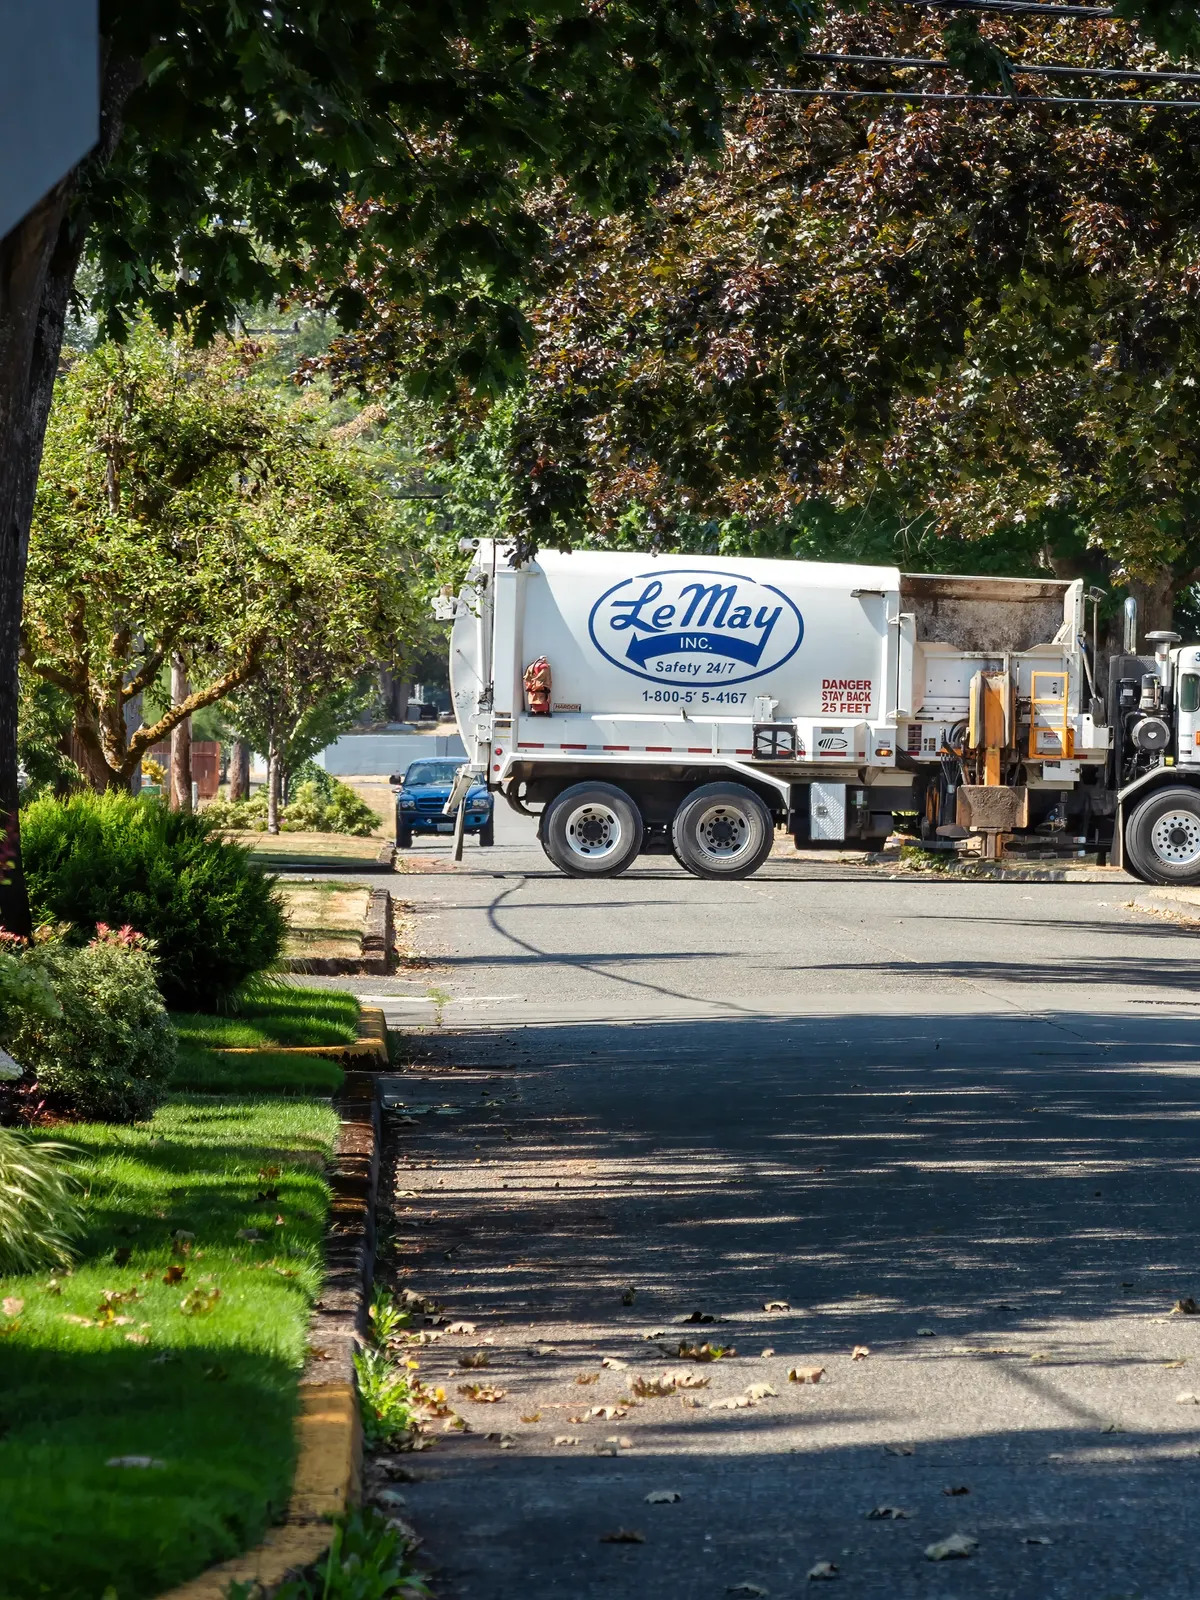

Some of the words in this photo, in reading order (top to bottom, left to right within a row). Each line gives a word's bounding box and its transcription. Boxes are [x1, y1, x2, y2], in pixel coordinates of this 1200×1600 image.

[680, 637, 713, 650] INC.
[655, 661, 701, 675] Safety
[706, 662, 736, 674] 24/7
[822, 679, 872, 690] DANGER
[642, 690, 747, 704] 1-800-55-4167
[821, 691, 845, 701] STAY
[846, 691, 872, 702] BACK
[821, 702, 837, 712] 25
[840, 703, 872, 713] FEET
